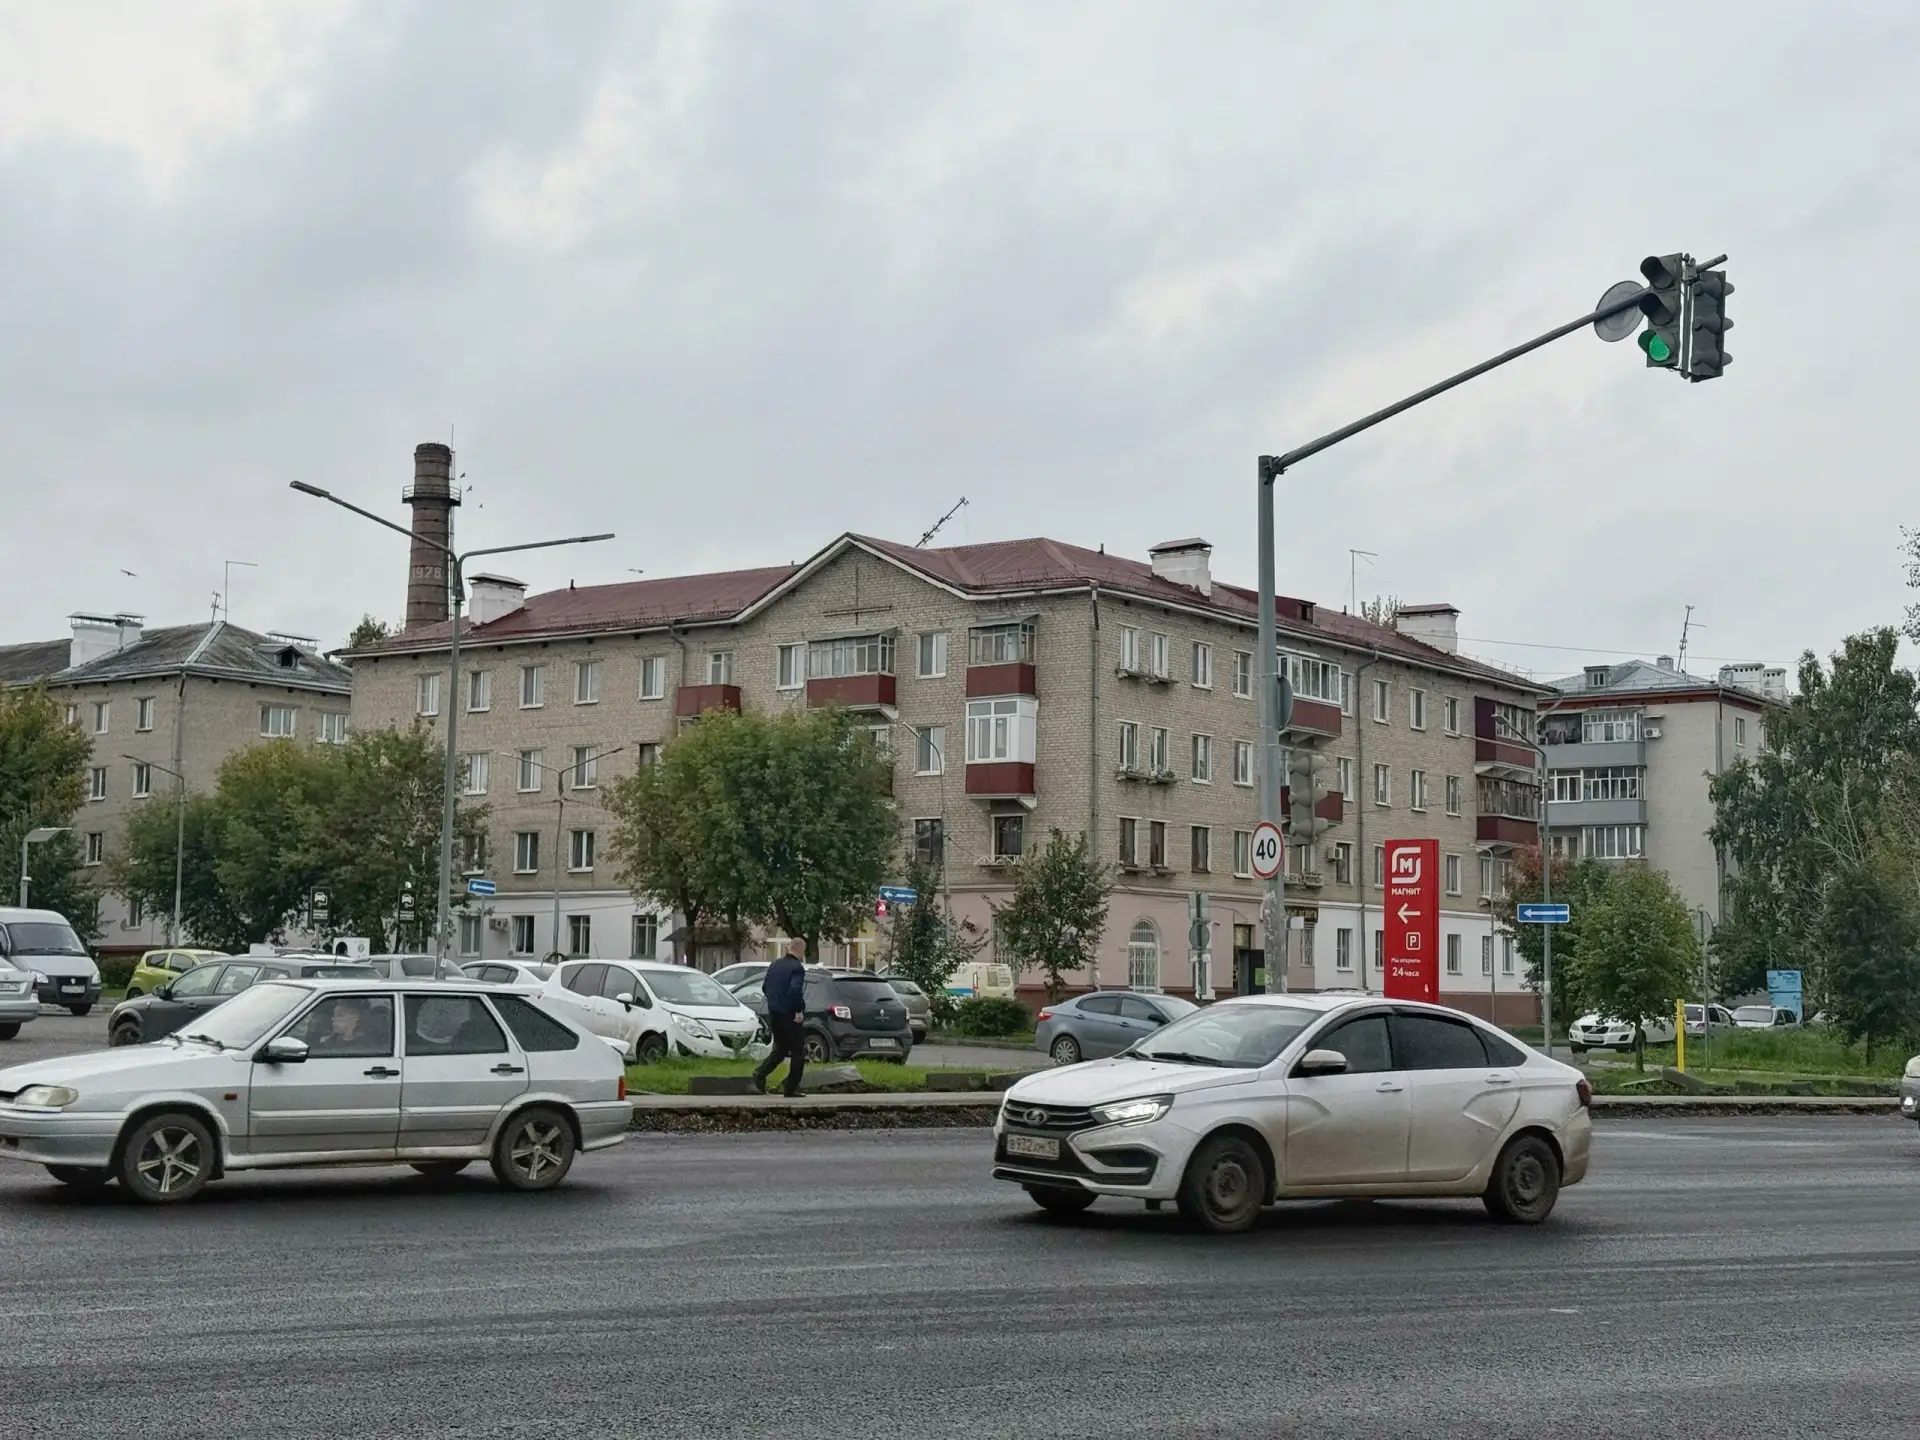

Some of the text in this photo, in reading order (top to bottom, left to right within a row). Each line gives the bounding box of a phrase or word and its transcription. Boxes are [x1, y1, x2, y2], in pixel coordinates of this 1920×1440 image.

[412, 566, 442, 579] 1928
[1256, 838, 1276, 860] 40
[1391, 887, 1421, 895] МАГНИТ
[1392, 966, 1403, 976] 24
